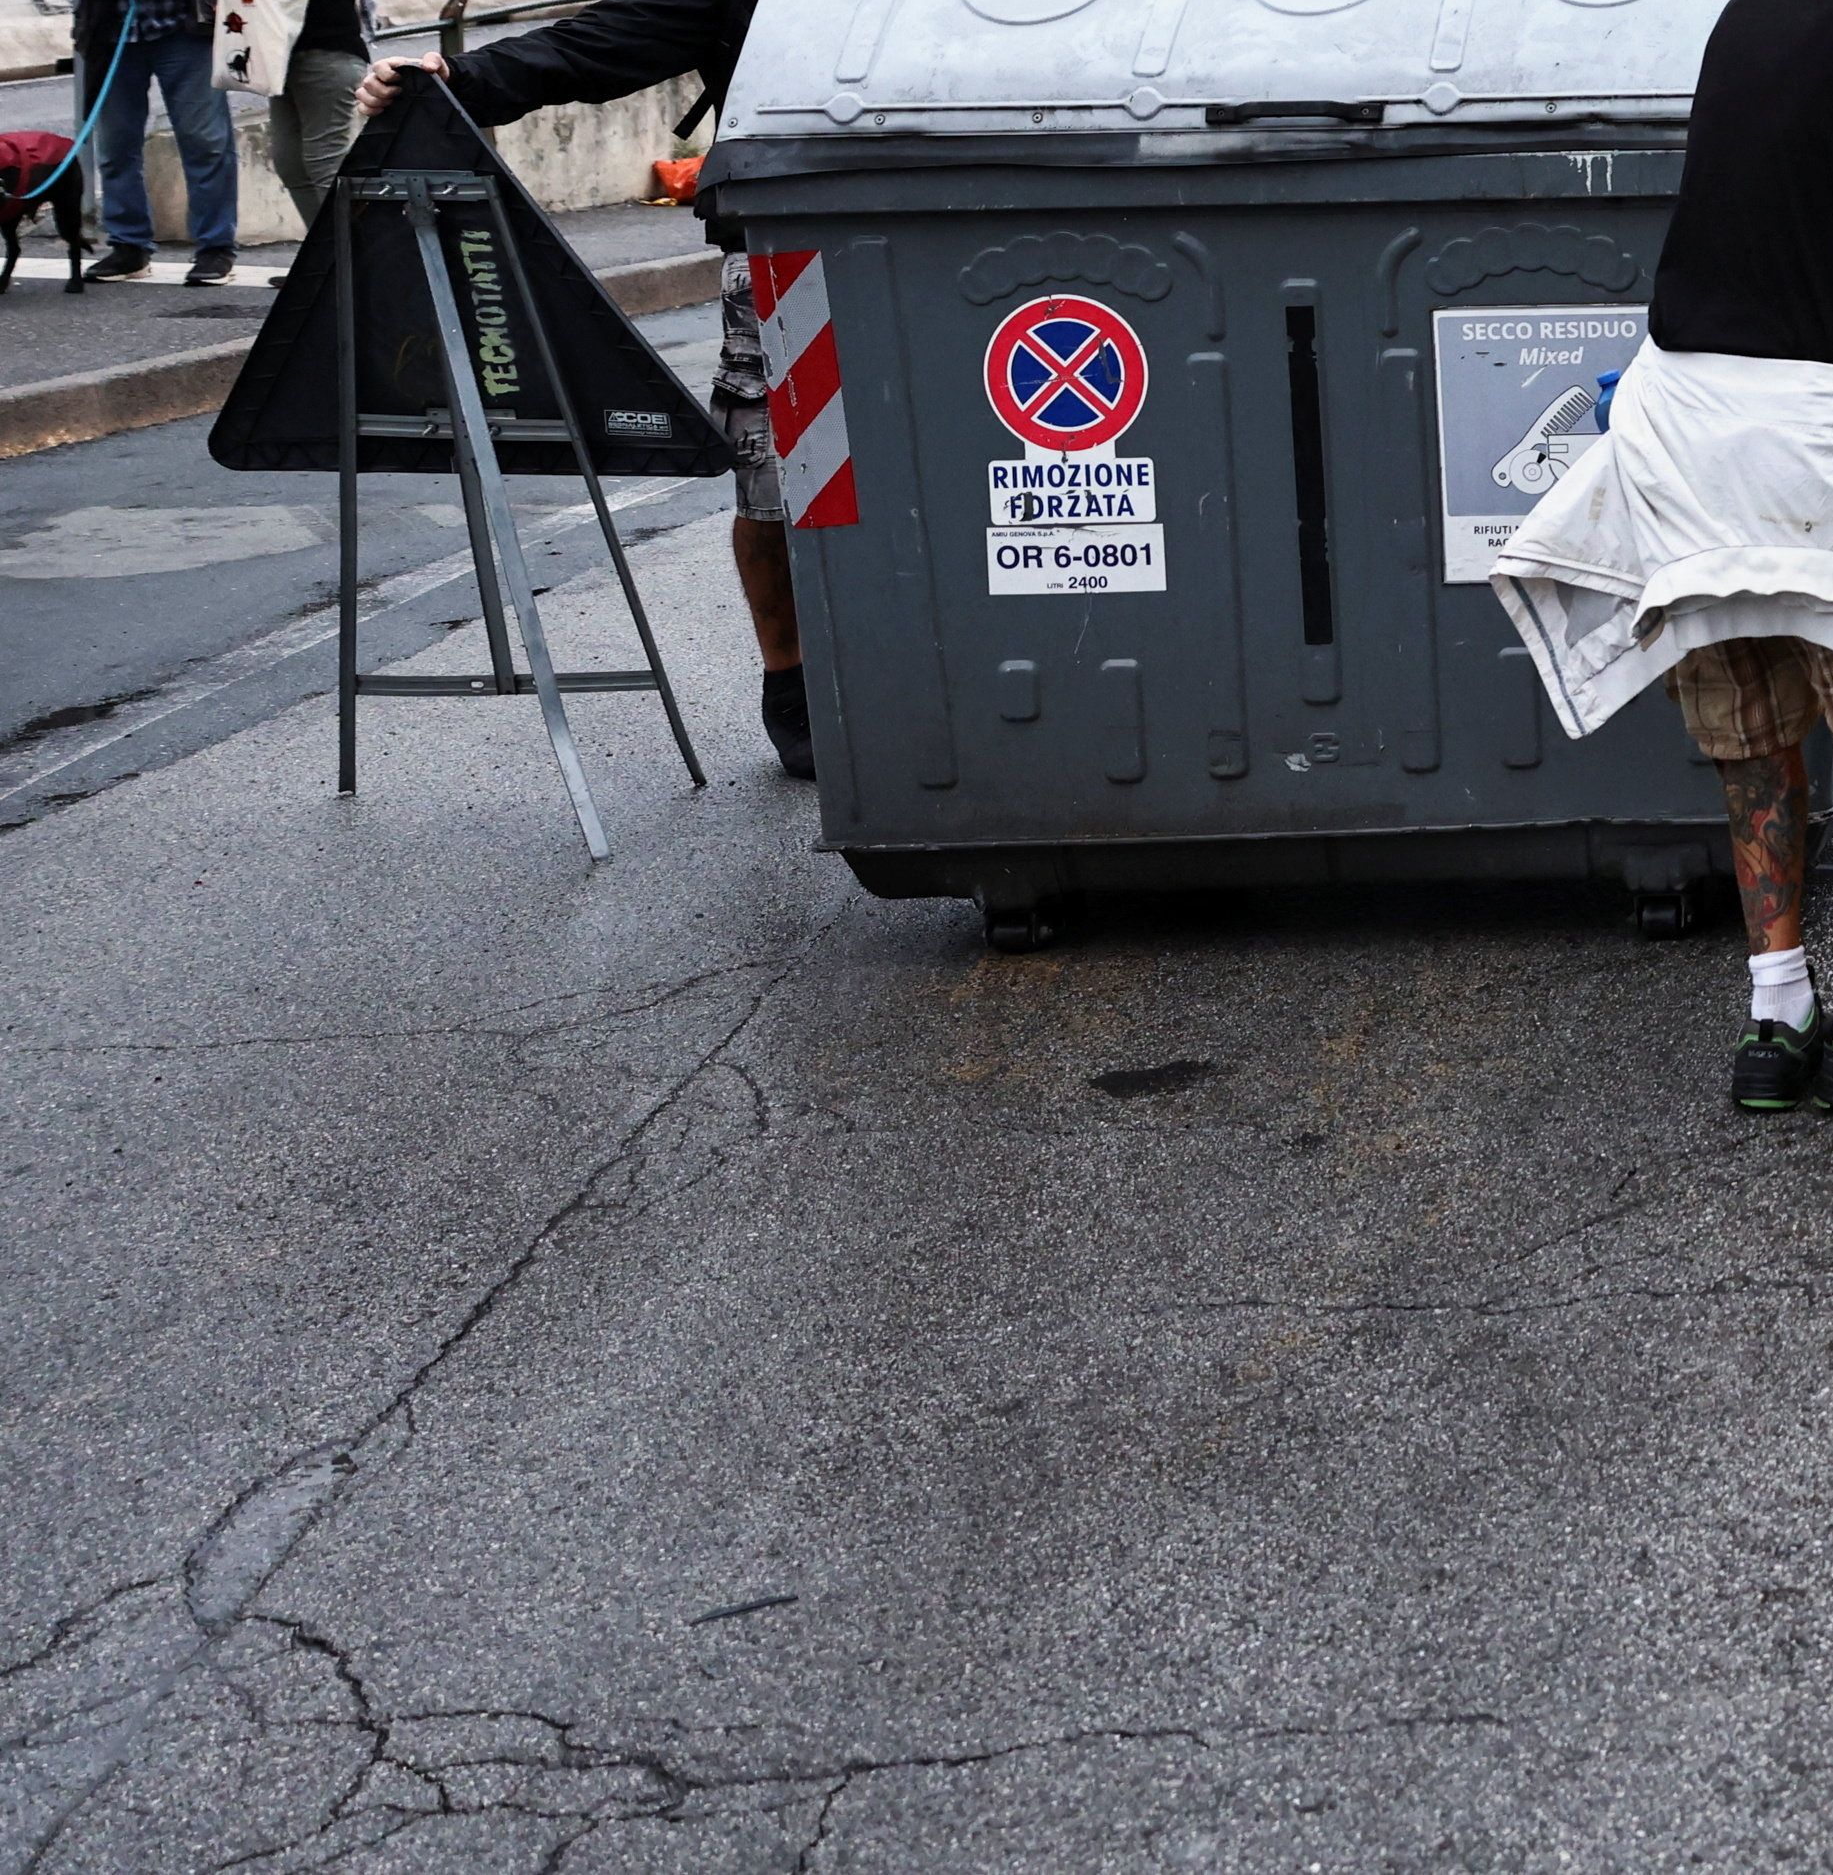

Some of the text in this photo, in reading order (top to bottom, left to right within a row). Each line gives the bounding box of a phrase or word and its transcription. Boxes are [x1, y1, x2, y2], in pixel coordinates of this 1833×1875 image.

[1462, 320, 1637, 340] SECCO RESIDUO
[1519, 346, 1584, 366] Mixed
[993, 463, 1150, 489] RIMOZIONE
[1474, 526, 1512, 534] RIFIUTI
[996, 543, 1152, 569] OR 6-0801
[1068, 576, 1108, 589] 2400
